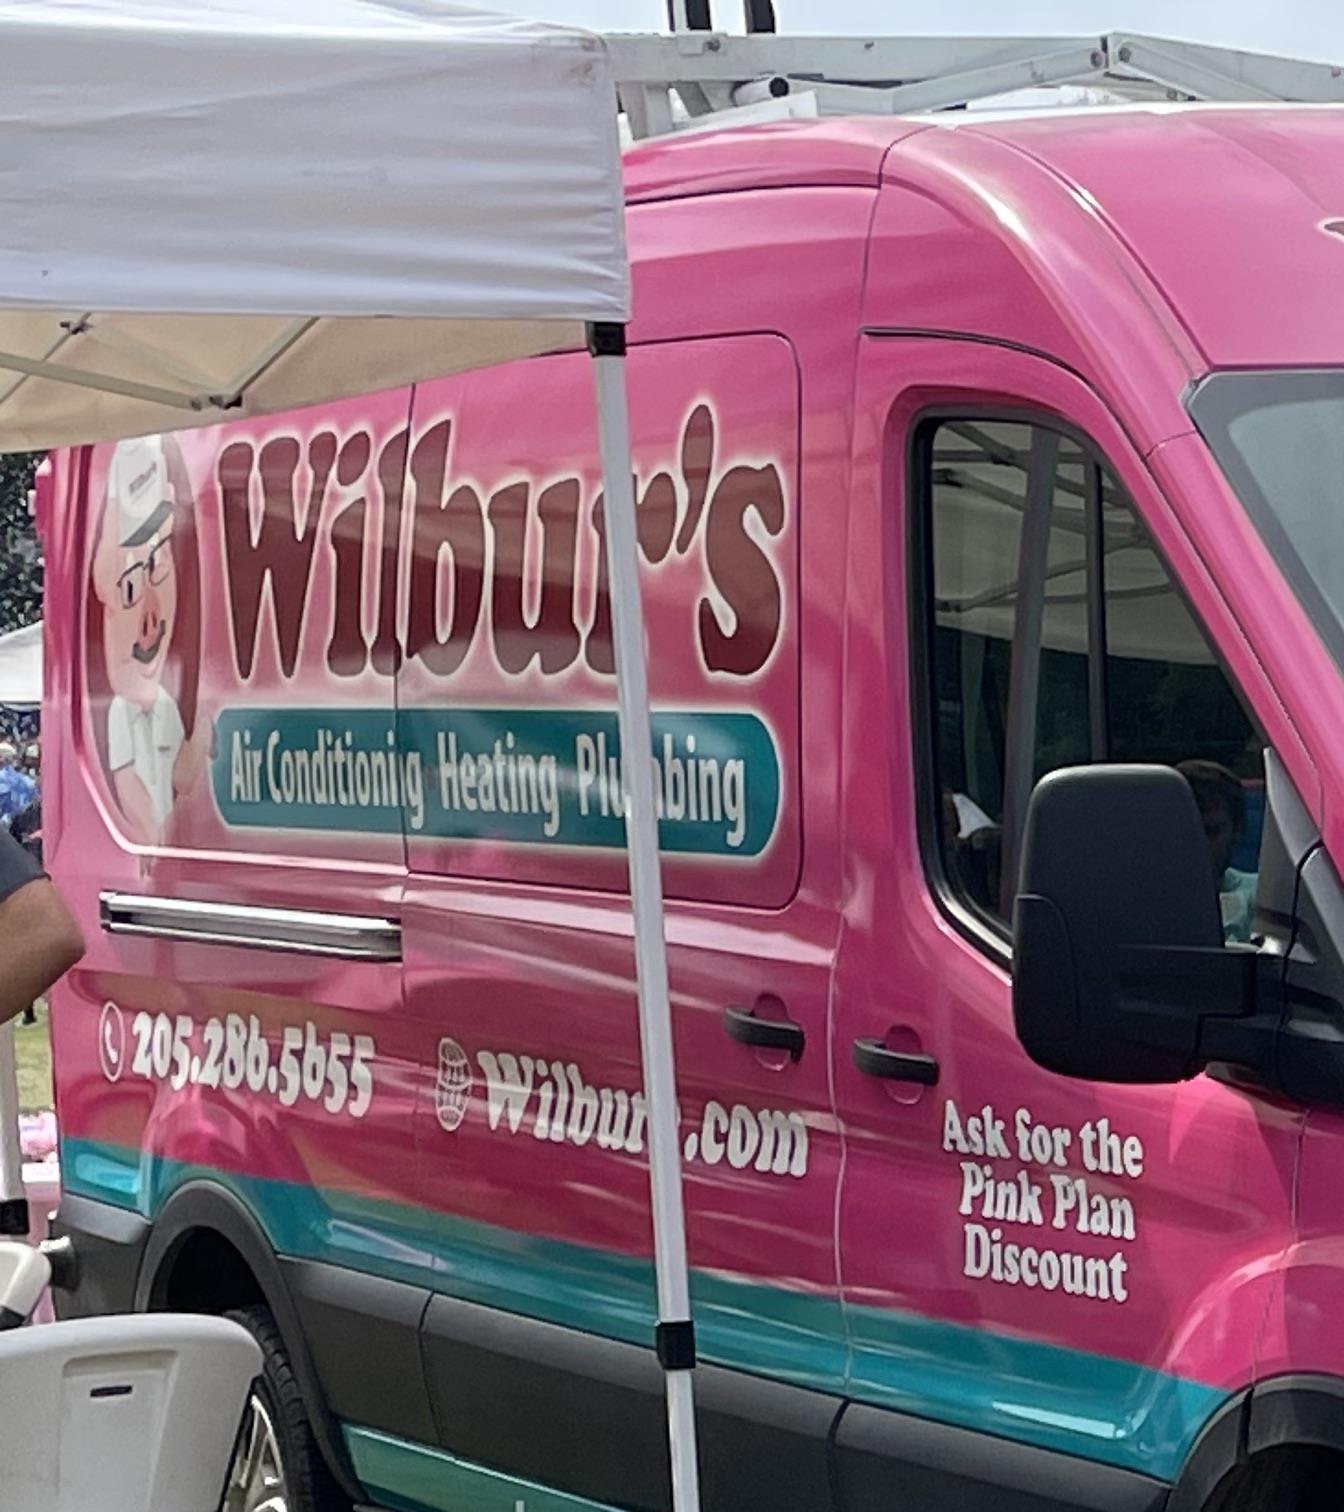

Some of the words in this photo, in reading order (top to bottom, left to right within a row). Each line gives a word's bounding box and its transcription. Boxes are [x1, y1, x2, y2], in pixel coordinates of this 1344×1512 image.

[217, 402, 786, 680] Wilbur's
[231, 730, 262, 802] Air
[437, 731, 560, 837] Heating
[131, 1011, 376, 1118] 205.286.5655
[476, 1050, 808, 1177] Wilbur.com
[941, 1099, 1011, 1161] Ask
[1014, 1107, 1071, 1167] for
[1080, 1117, 1144, 1178] the
[958, 1161, 1043, 1226] Pink
[1050, 1174, 1136, 1240] Plan
[963, 1223, 1128, 1303] Discount
